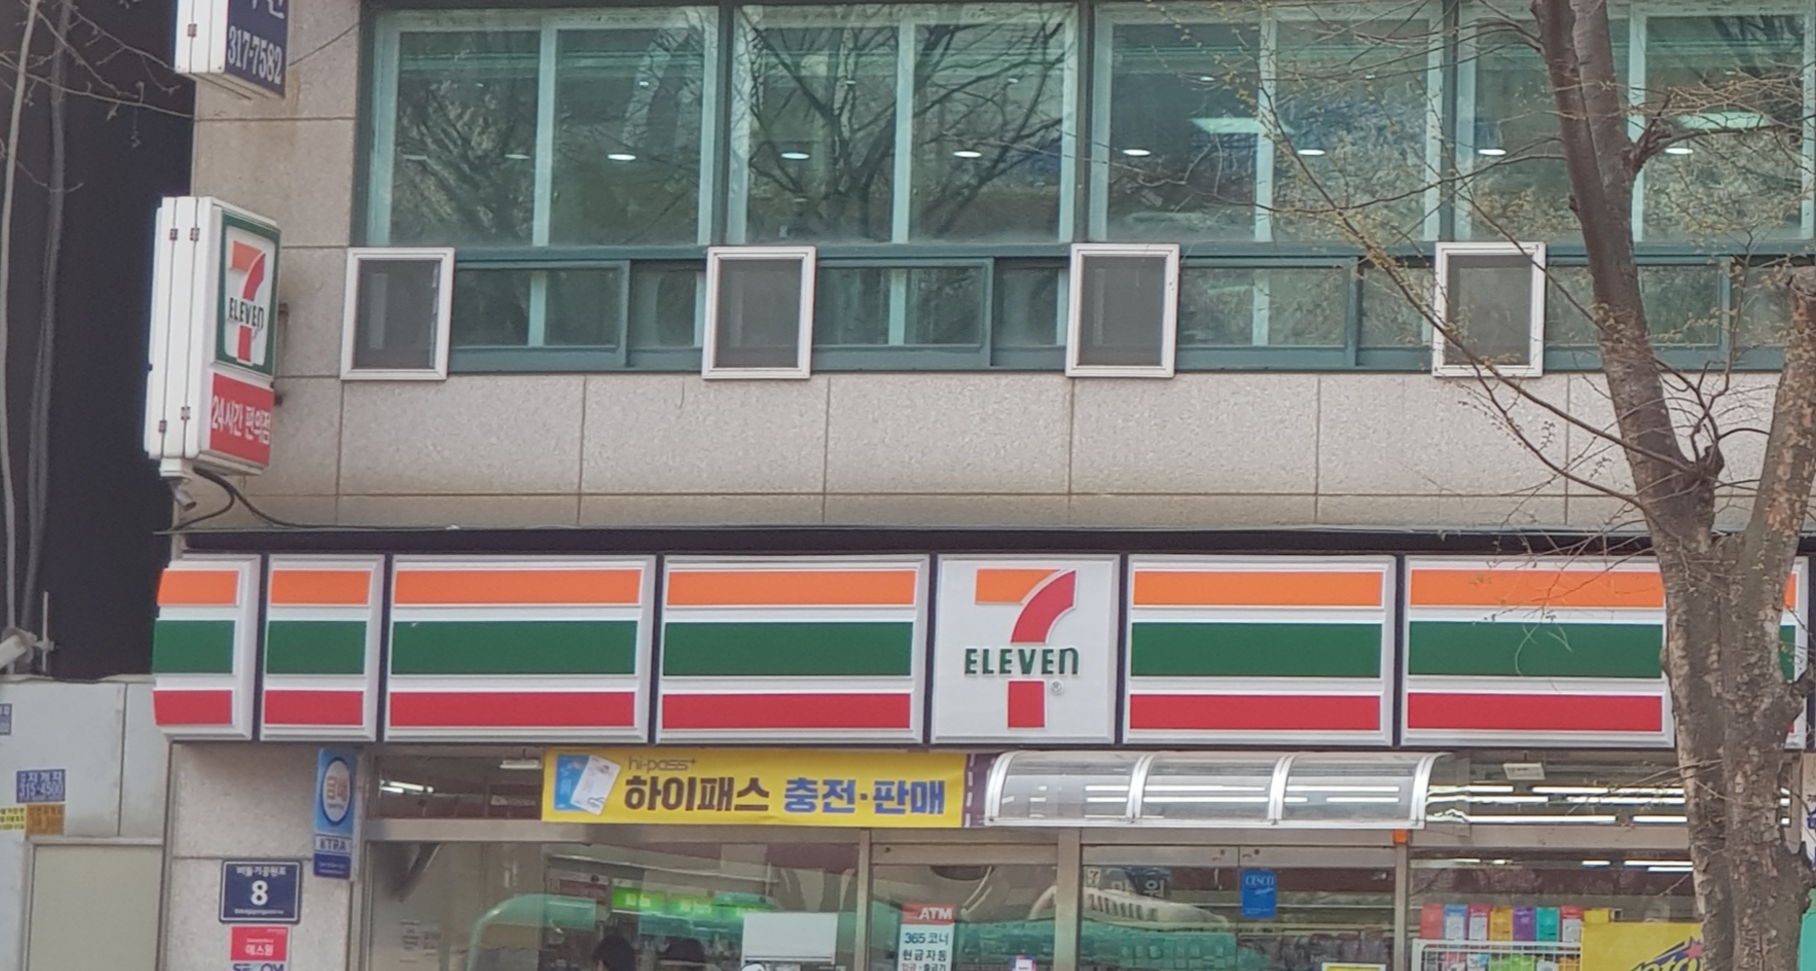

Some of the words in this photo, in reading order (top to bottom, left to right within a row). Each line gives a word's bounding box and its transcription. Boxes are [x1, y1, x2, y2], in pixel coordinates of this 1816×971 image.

[227, 24, 284, 86] 317-7582
[211, 396, 244, 438] 24시간
[245, 406, 272, 445] 편의점
[624, 775, 770, 812] 하이패스
[250, 879, 269, 906] 8
[918, 907, 953, 920] ATM
